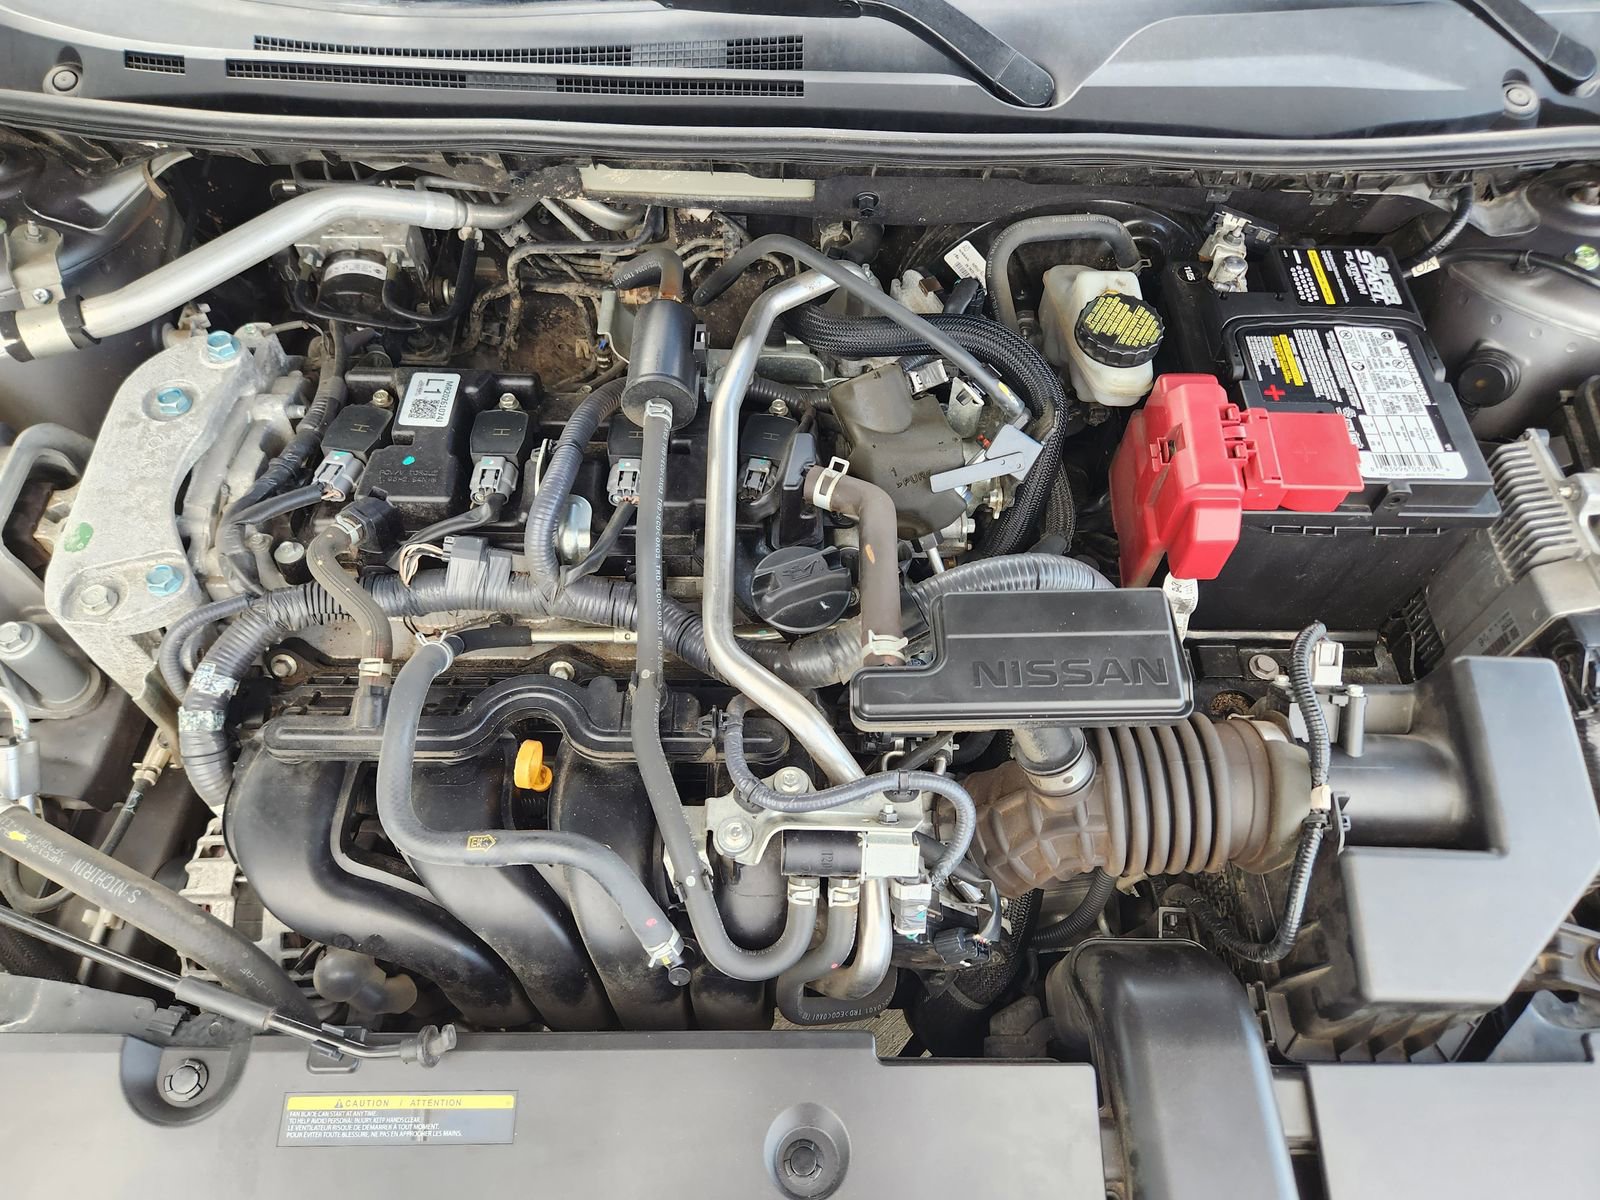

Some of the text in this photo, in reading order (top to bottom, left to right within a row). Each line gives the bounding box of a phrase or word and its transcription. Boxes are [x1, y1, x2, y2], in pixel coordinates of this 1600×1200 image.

[1343, 250, 1369, 295] PLATINUM
[1355, 249, 1385, 304] START
[1373, 255, 1403, 306] SUPER
[423, 378, 445, 394] L1
[971, 656, 1170, 689] NISSAN
[344, 1099, 390, 1107] CAUTION
[409, 1099, 462, 1107] ATTENTION
